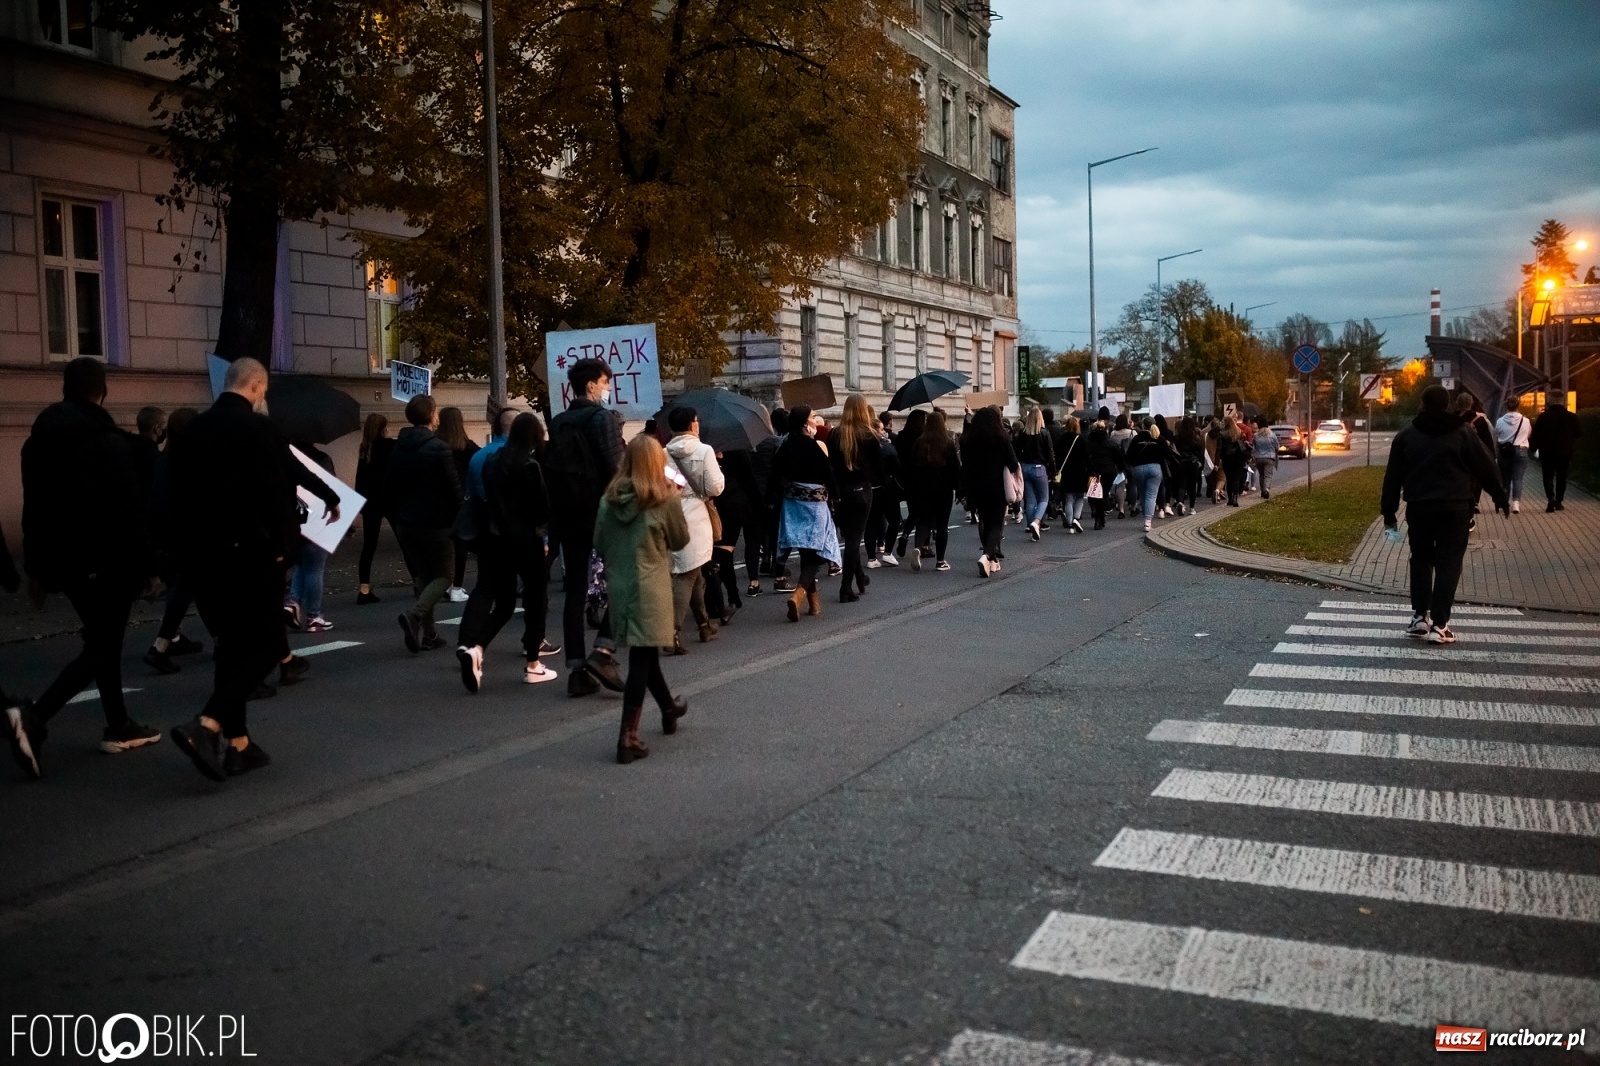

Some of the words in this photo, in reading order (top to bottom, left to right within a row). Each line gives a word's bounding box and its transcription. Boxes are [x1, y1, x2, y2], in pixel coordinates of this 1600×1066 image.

[556, 338, 649, 370] #STRAJK
[1440, 364, 1444, 372] 1
[561, 372, 641, 410] KET
